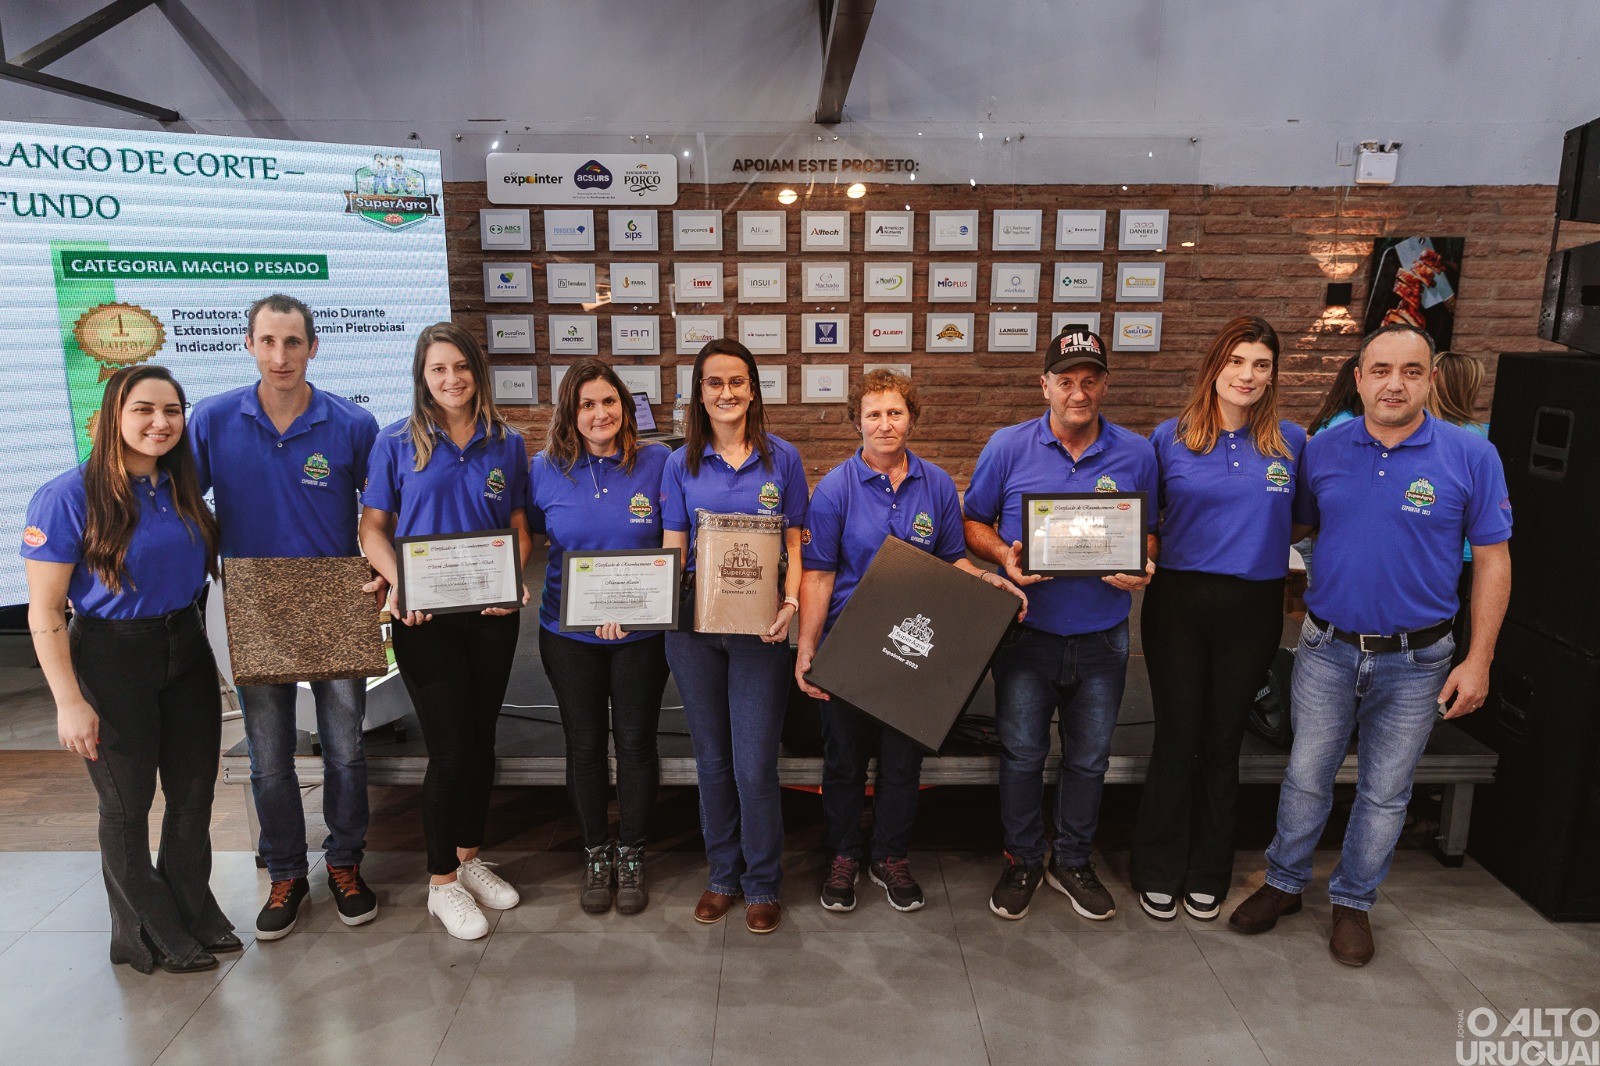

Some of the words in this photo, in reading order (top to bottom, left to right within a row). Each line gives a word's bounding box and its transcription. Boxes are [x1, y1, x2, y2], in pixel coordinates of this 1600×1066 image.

[0, 142, 112, 172] ANGO
[117, 148, 167, 174] DE
[174, 151, 279, 180] CORTE
[732, 159, 794, 172] APOIAM
[798, 159, 838, 172] ESTE
[841, 159, 920, 173] PROJETO:
[624, 175, 661, 185] PORCO
[355, 197, 428, 210] SuperAgro
[624, 232, 642, 241] sips
[811, 228, 839, 236] Alltech
[71, 259, 178, 273] CATEGORIA
[182, 261, 249, 273] MACHO
[254, 261, 320, 274] PESADO
[693, 278, 712, 287] imv
[172, 309, 242, 320] Produtora:
[312, 307, 338, 318] onio
[341, 308, 386, 318] Durante
[174, 325, 247, 336] Extensionis
[345, 322, 405, 333] Pietrobiasi
[1060, 332, 1100, 349] FILA
[176, 341, 243, 353] Indicador:
[722, 568, 757, 578] SuperAgro
[721, 588, 745, 596] Expointer
[894, 631, 926, 651] SuperAgro
